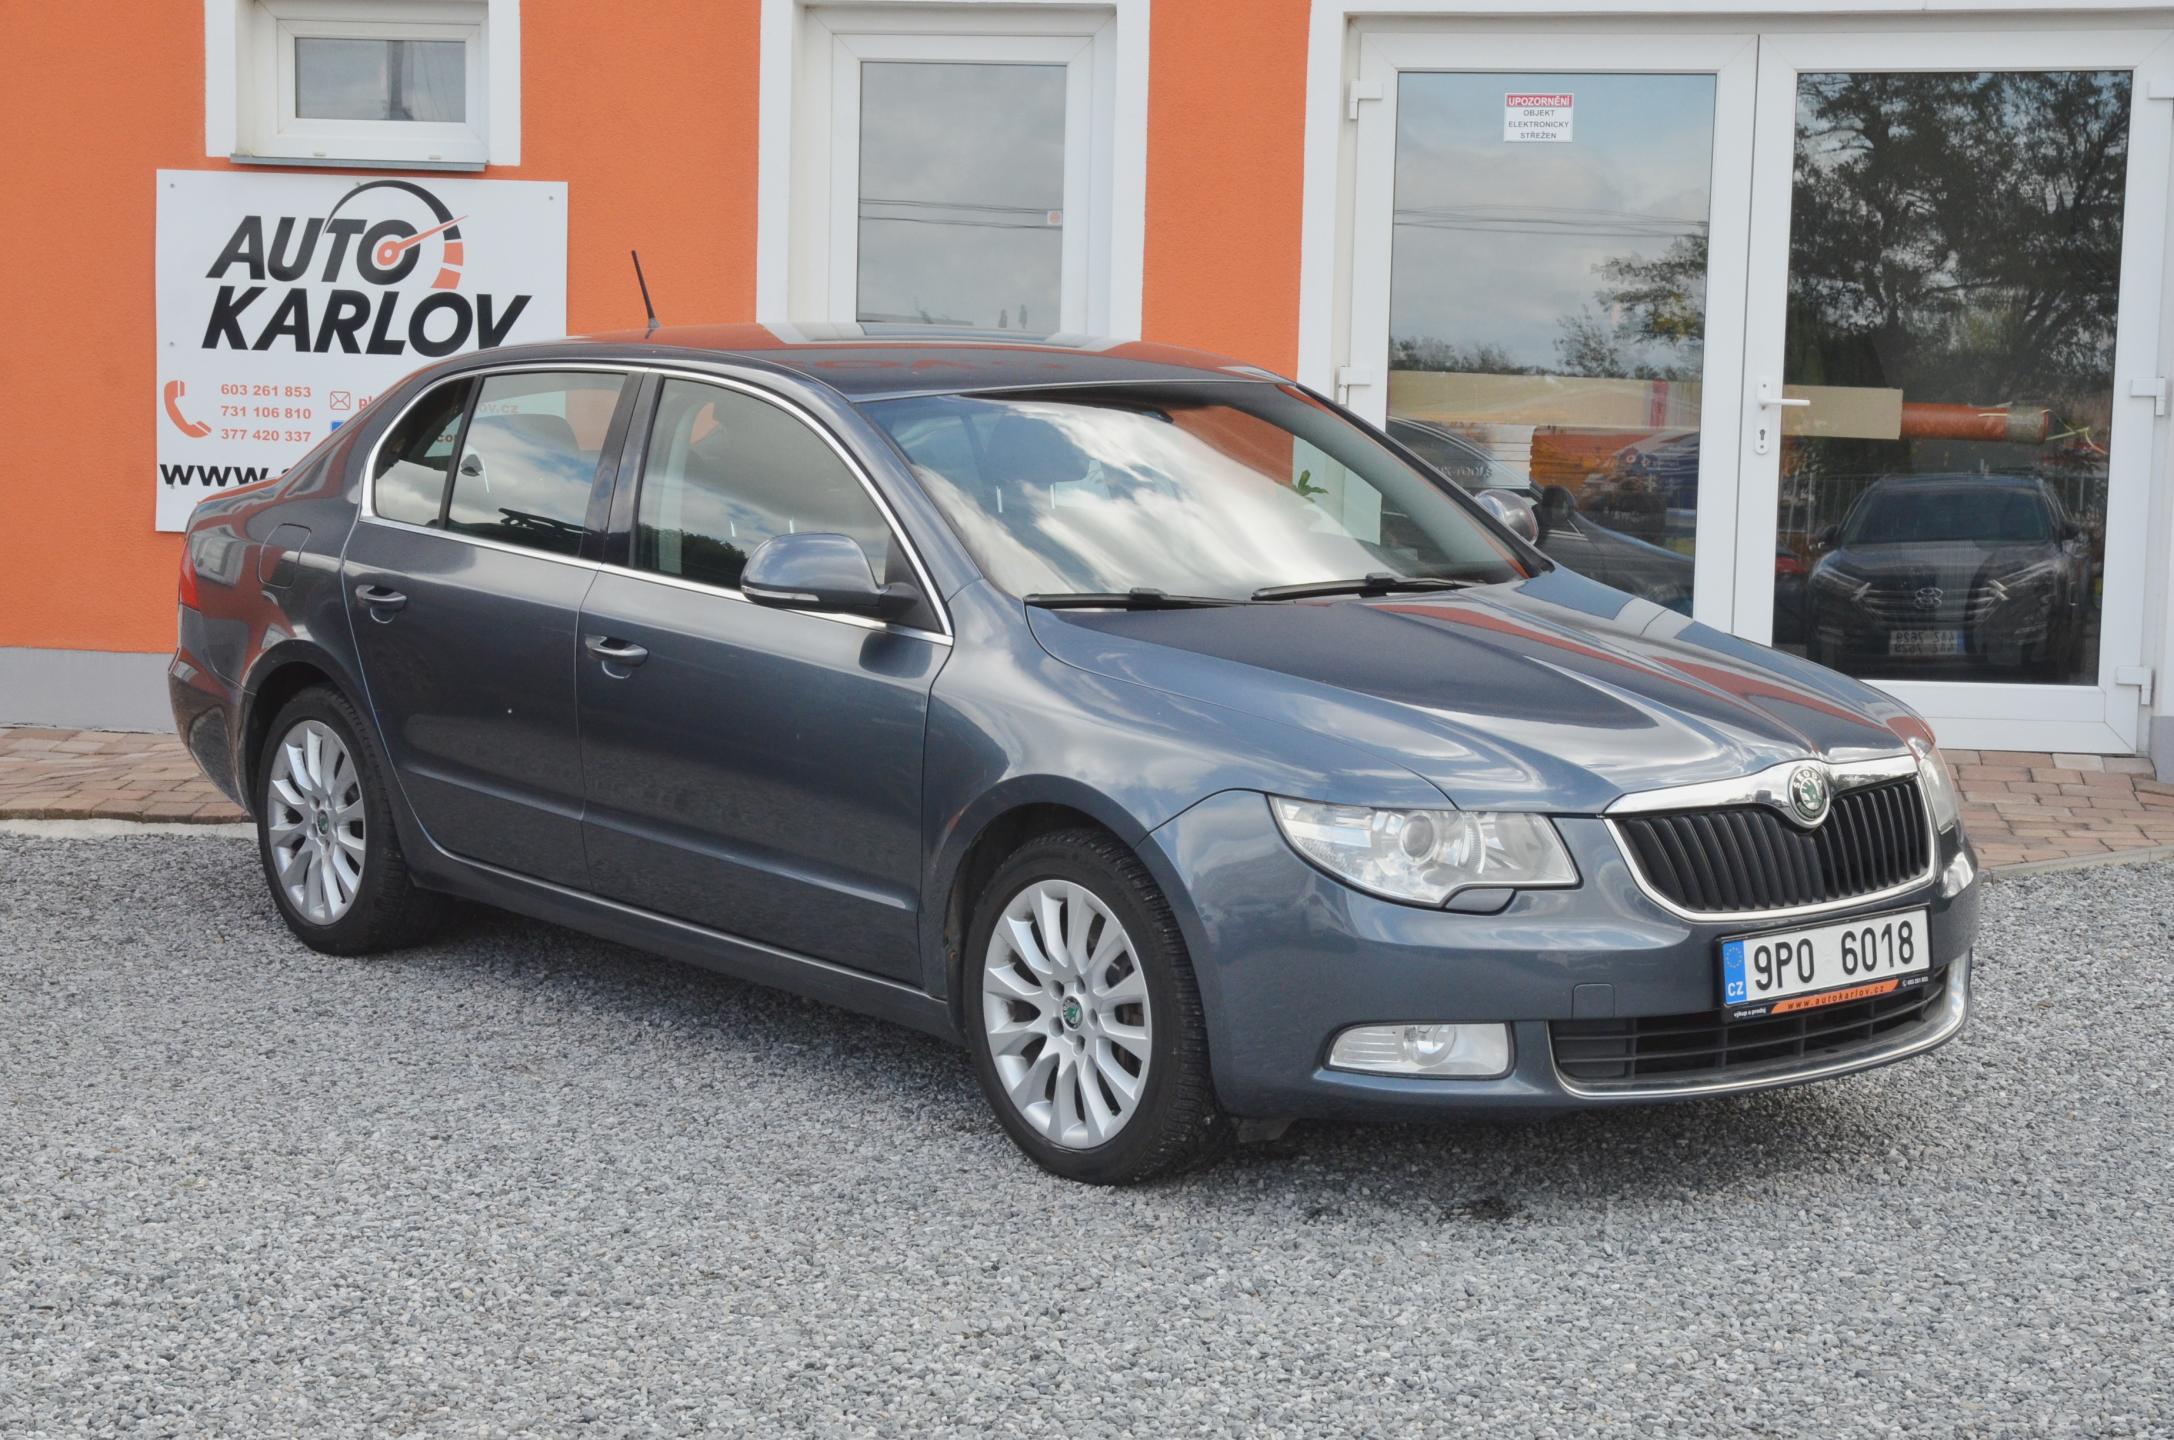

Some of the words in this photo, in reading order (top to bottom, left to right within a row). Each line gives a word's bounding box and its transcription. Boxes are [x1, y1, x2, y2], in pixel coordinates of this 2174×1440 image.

[1508, 95, 1570, 106] UPOZORNĚNÍ
[1523, 109, 1555, 117] OBJEKT
[1508, 120, 1569, 128] ELEKTRONICKY
[1520, 131, 1557, 139] STŘEŽEN
[205, 215, 421, 286] AUTO
[201, 285, 533, 358] KARLOV
[220, 383, 248, 396] 603
[253, 385, 279, 397] 261
[284, 386, 312, 398] 853
[220, 405, 247, 417] 731
[253, 407, 280, 418] 106
[284, 408, 312, 420] 810
[220, 428, 248, 441] 377
[252, 429, 280, 442] 420
[284, 430, 312, 443] 337
[1841, 920, 1914, 976] 6018
[1727, 981, 1744, 996] CZ
[1787, 985, 1884, 1009] www.autokarlov.cz
